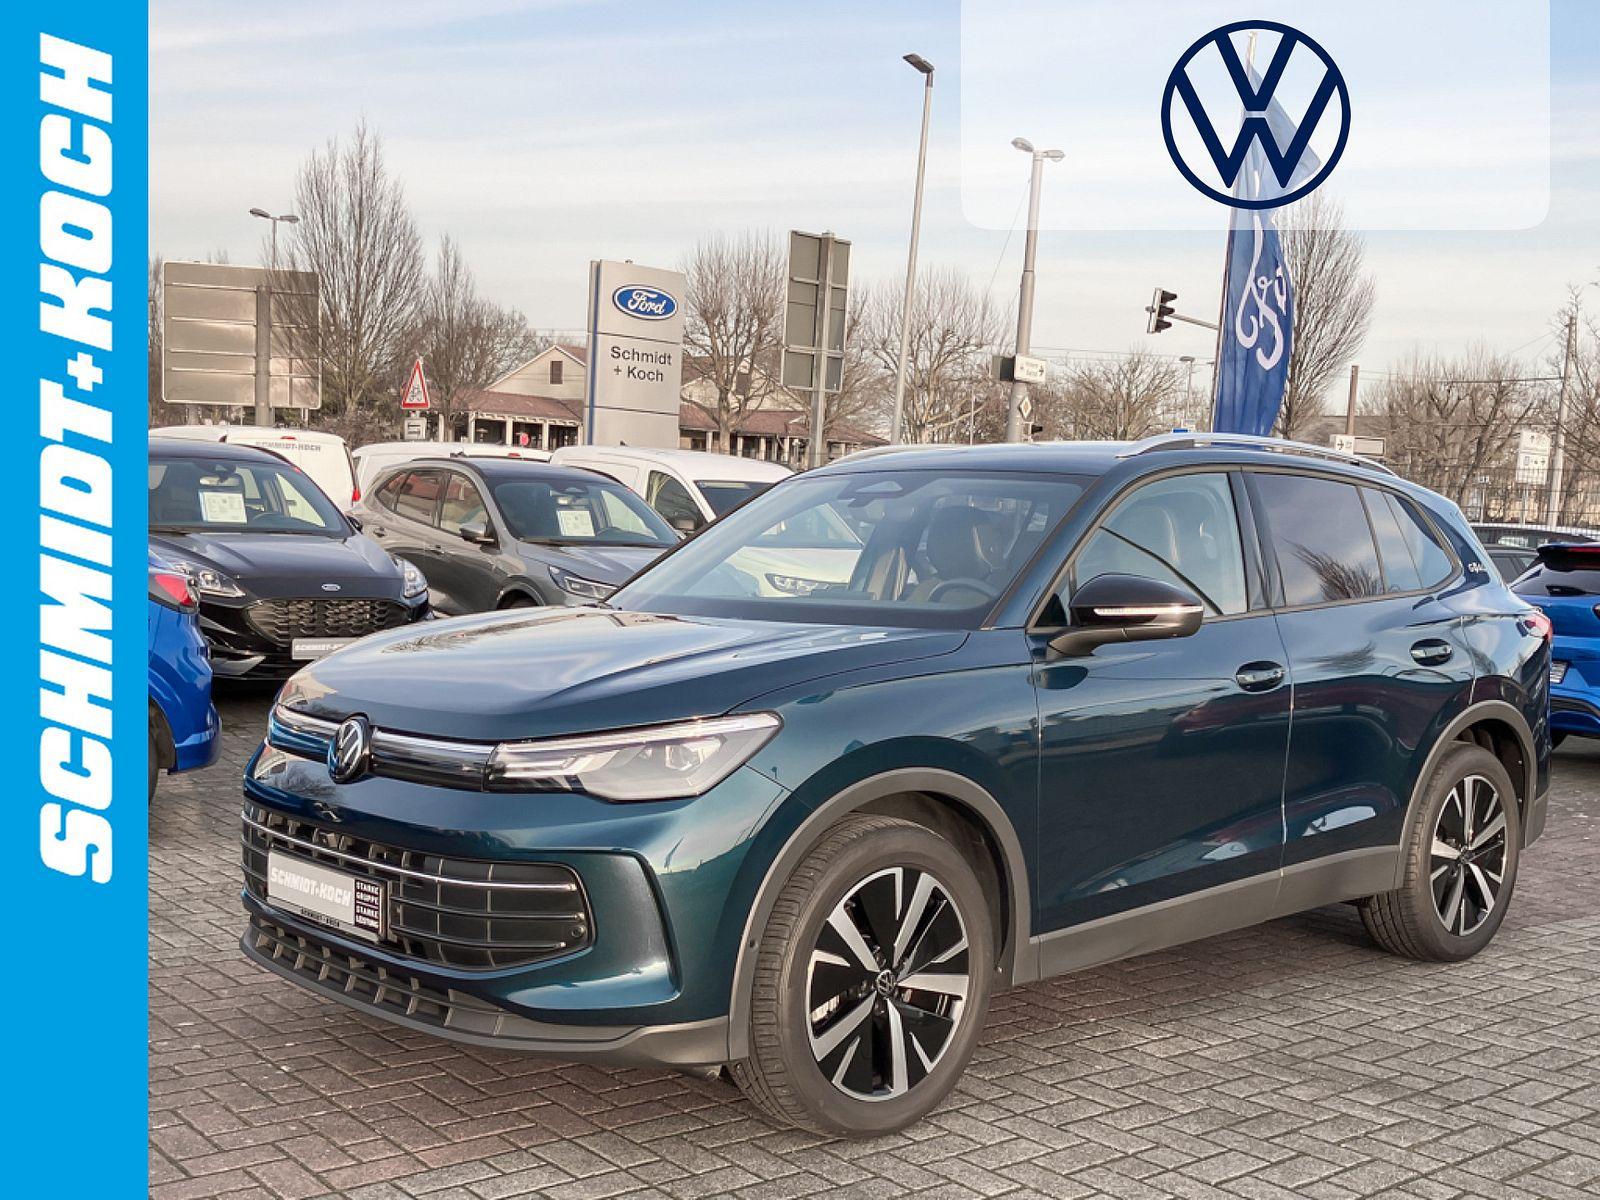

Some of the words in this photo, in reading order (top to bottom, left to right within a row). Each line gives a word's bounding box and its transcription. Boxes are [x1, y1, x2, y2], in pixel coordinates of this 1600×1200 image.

[628, 290, 666, 314] Ford
[610, 345, 673, 366] Schmidt
[613, 365, 622, 376] +
[627, 365, 664, 382] Koch
